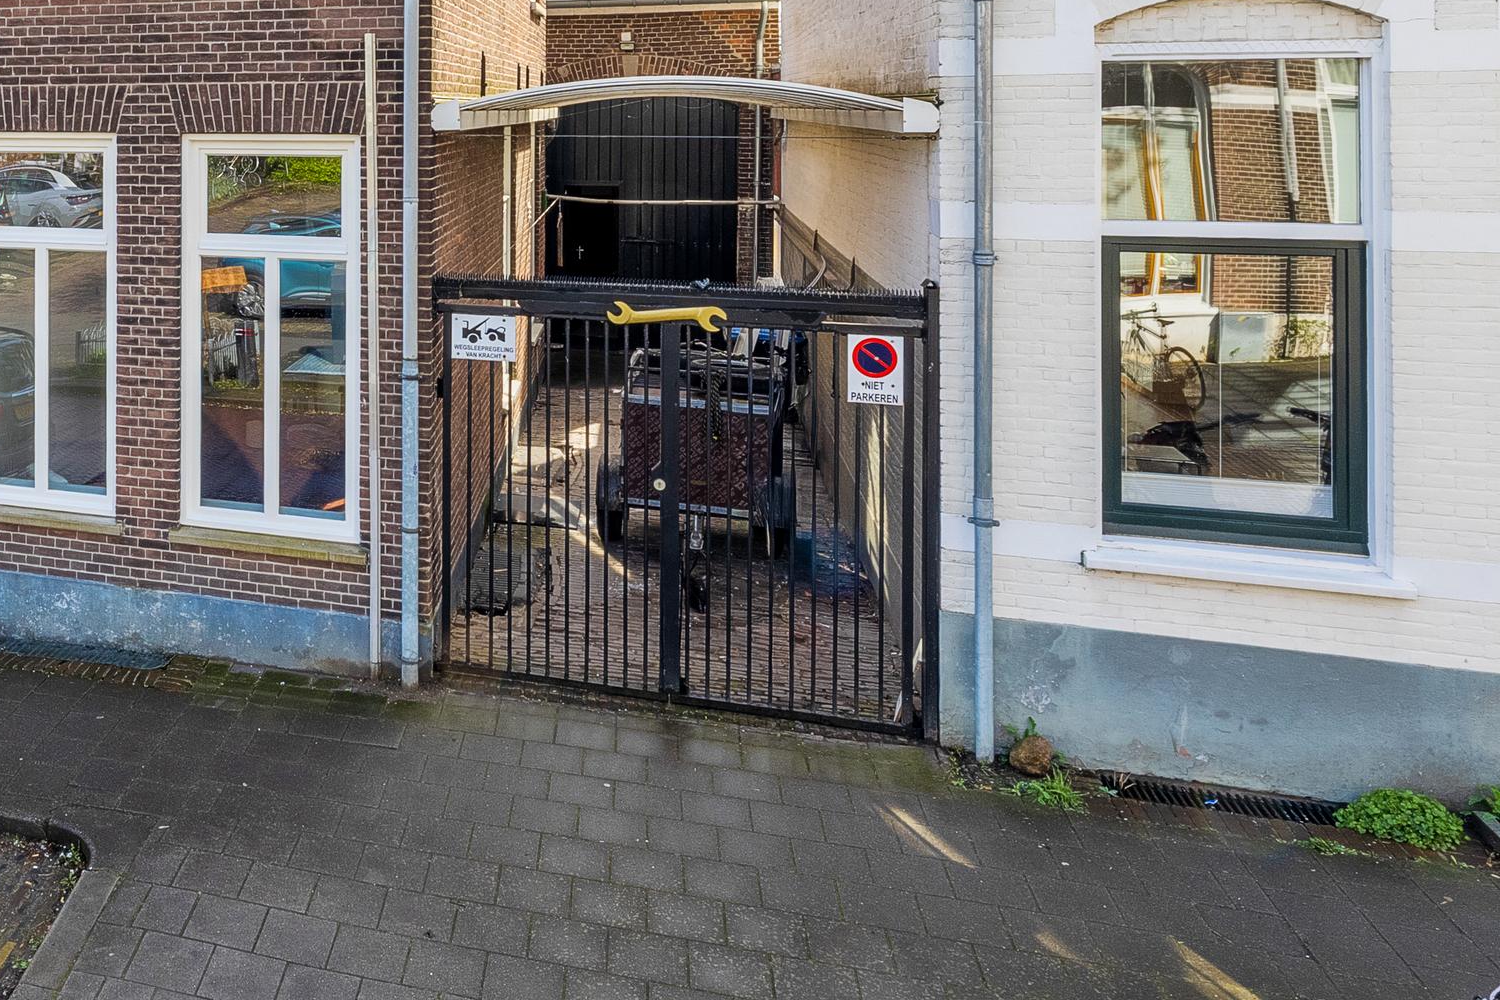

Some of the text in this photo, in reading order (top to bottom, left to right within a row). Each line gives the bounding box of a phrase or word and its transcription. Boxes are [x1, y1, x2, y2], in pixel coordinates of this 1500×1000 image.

[454, 344, 514, 353] WEGSLEEPREGELING
[864, 381, 884, 390] NIET
[850, 391, 899, 404] PARKEREN
